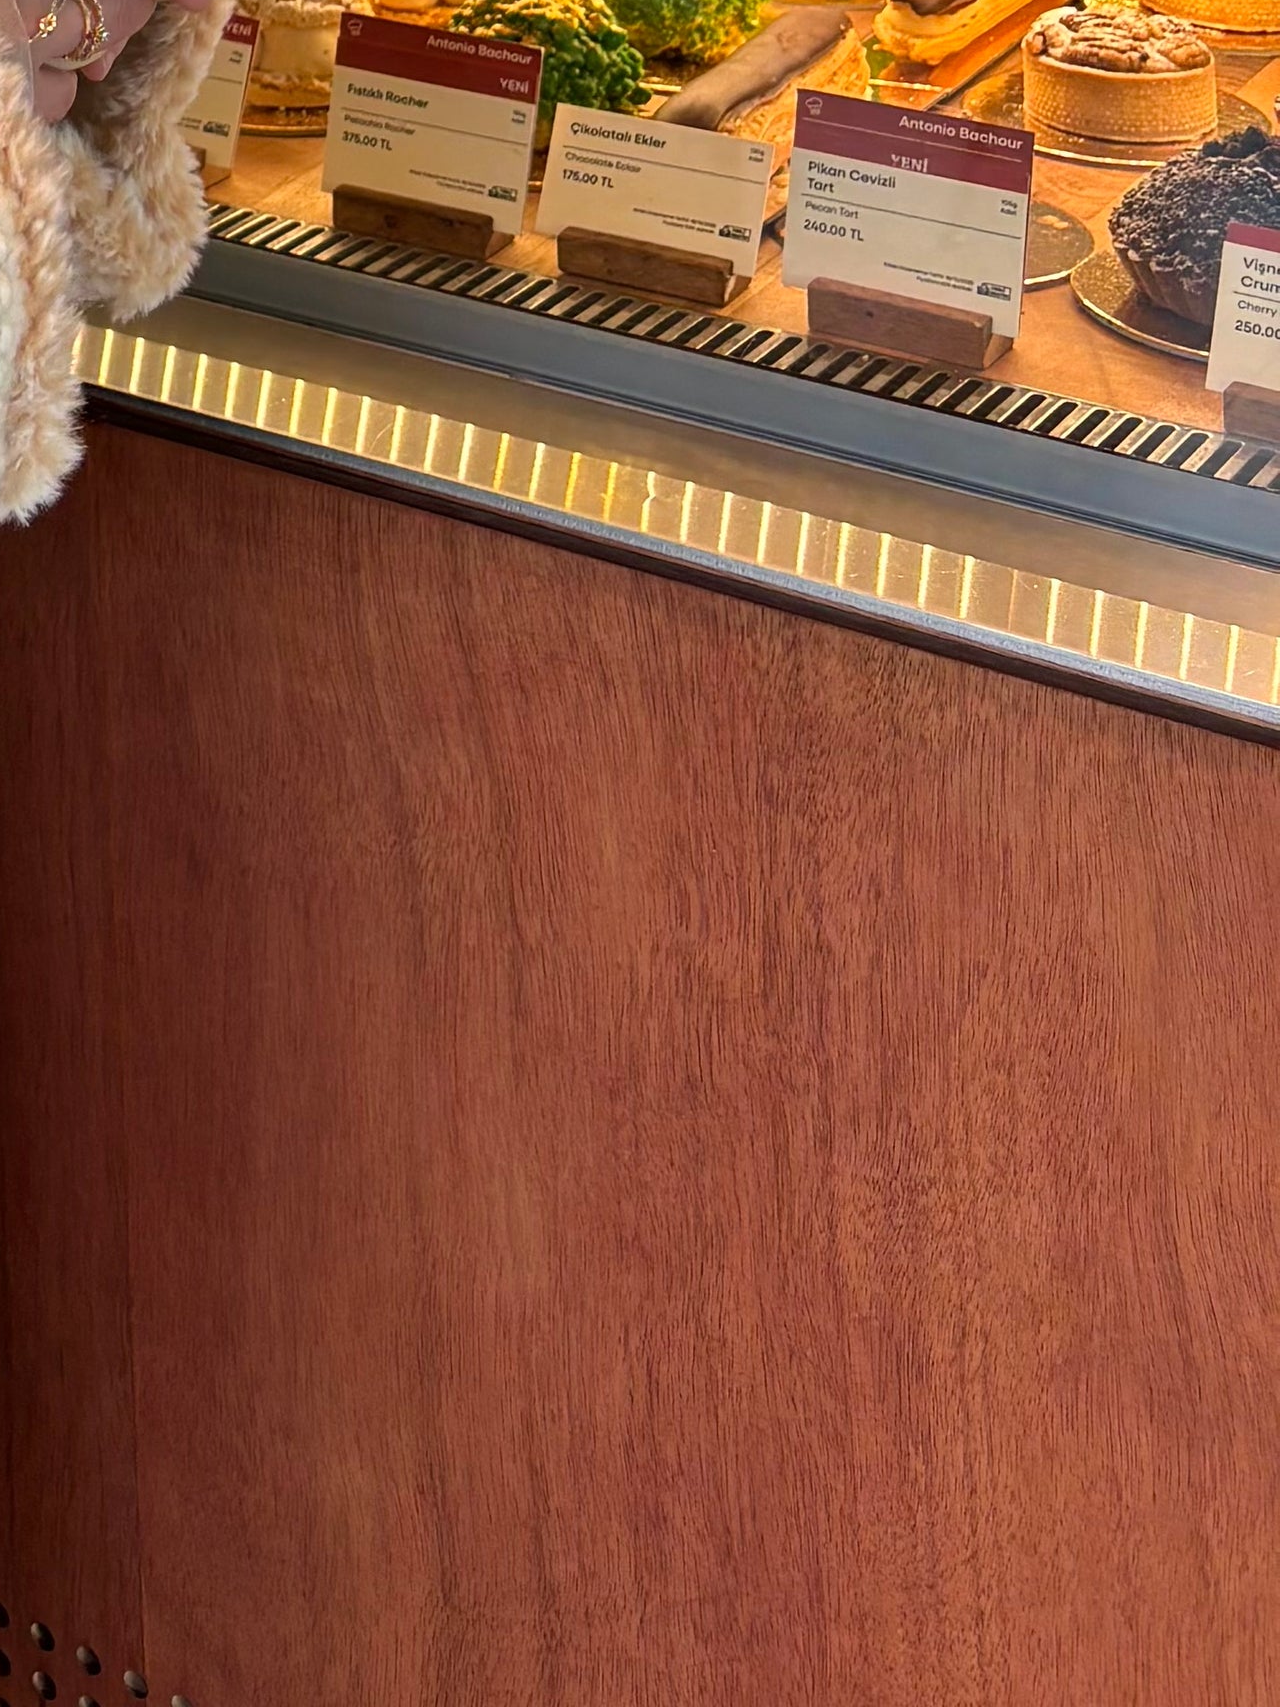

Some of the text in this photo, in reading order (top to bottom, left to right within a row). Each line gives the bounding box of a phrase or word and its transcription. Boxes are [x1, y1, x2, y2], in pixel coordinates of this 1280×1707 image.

[426, 35, 533, 65] Antonio Bachour
[347, 83, 429, 108] Fıstıklı Rocher
[500, 77, 529, 94] YENİ
[384, 121, 415, 136] Rocher
[570, 121, 667, 149] Çikolatalı Ekler
[898, 114, 1024, 150] Antonio Bachour
[342, 130, 392, 151] 375.00 TL
[565, 151, 614, 167] Chocolate
[891, 153, 929, 174] YENİ
[562, 168, 614, 189] 175.00 TL
[808, 160, 896, 189] Pikan Cevizli
[807, 177, 834, 194] Tart
[805, 200, 859, 219] Pecan Tart
[803, 218, 864, 242] 240.00 TL
[1237, 299, 1278, 318] Cherry
